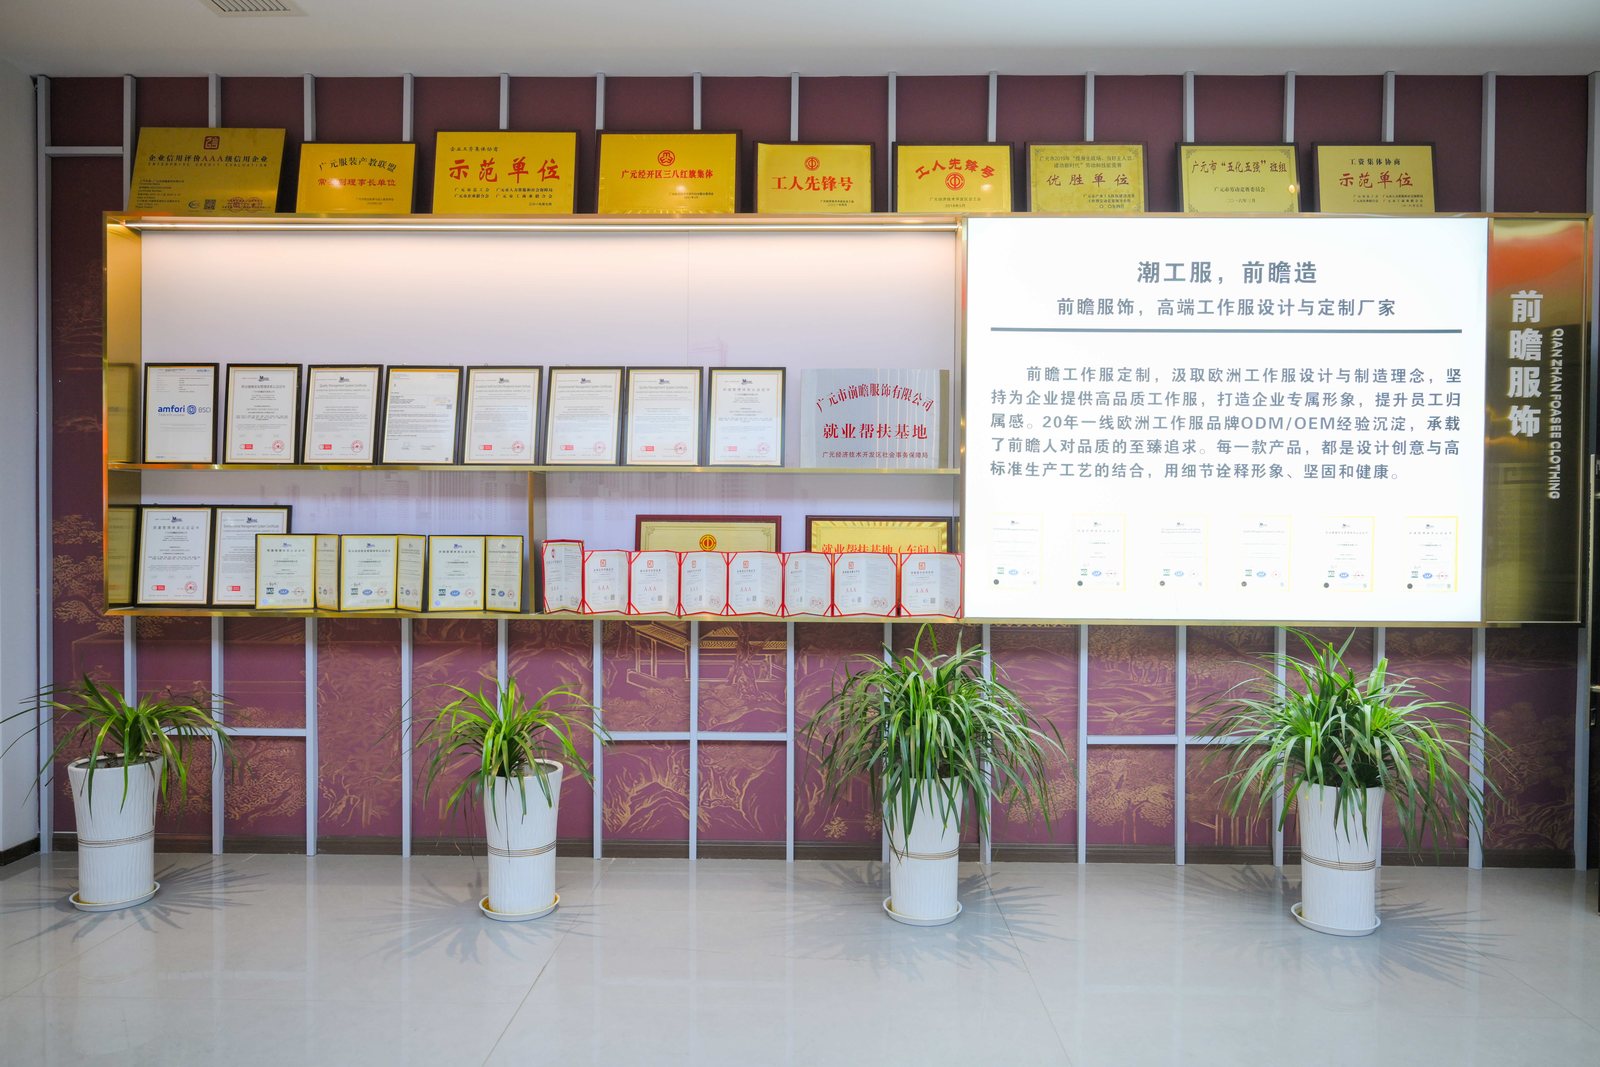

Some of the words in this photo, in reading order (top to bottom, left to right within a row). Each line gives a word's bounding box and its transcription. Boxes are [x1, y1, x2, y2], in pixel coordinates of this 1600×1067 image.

[319, 157, 397, 172] 广元服装产教联盟
[449, 156, 560, 184] 示范单位
[915, 158, 995, 180] 工人先锋号
[1192, 160, 1287, 174] 广元市“五化五强”班组
[1350, 158, 1400, 166] 工资集体协商
[318, 178, 396, 186] 常副理事长单位
[621, 169, 713, 179] 广元经开区三八红旗集体
[770, 176, 853, 191] 工人先锋号
[1046, 173, 1129, 187] 优胜单位
[1339, 170, 1413, 189] 示范单位
[1137, 261, 1317, 284] 潮工服，前瞻造
[1057, 297, 1396, 316] 前瞻服饰，高端工作服设计与定制厂家
[1551, 328, 1564, 358] QIAN
[1507, 290, 1544, 437] 前瞻服饰
[1027, 366, 1462, 384] 前瞻工作服定制，汲取欧洲工作服设计与制造理念，坚
[1550, 360, 1563, 392] ZHAN
[816, 384, 934, 412] 广元市前瞻服饰有限公司
[991, 389, 1460, 408] 持为企业提供高品质工作服，打造企业专属形象，提升员工归
[158, 405, 185, 413] amfori
[1549, 394, 1563, 439] FOASEE
[823, 423, 928, 439] 就业帮扶基地
[991, 437, 1460, 456] 了前瞻人对品质的至臻追求。每一款产品，都是设计创意与高
[990, 461, 1398, 480] 标准生产工艺的结合，用细节诠释形象、坚固和健康。
[1548, 441, 1562, 500] CLOTHING
